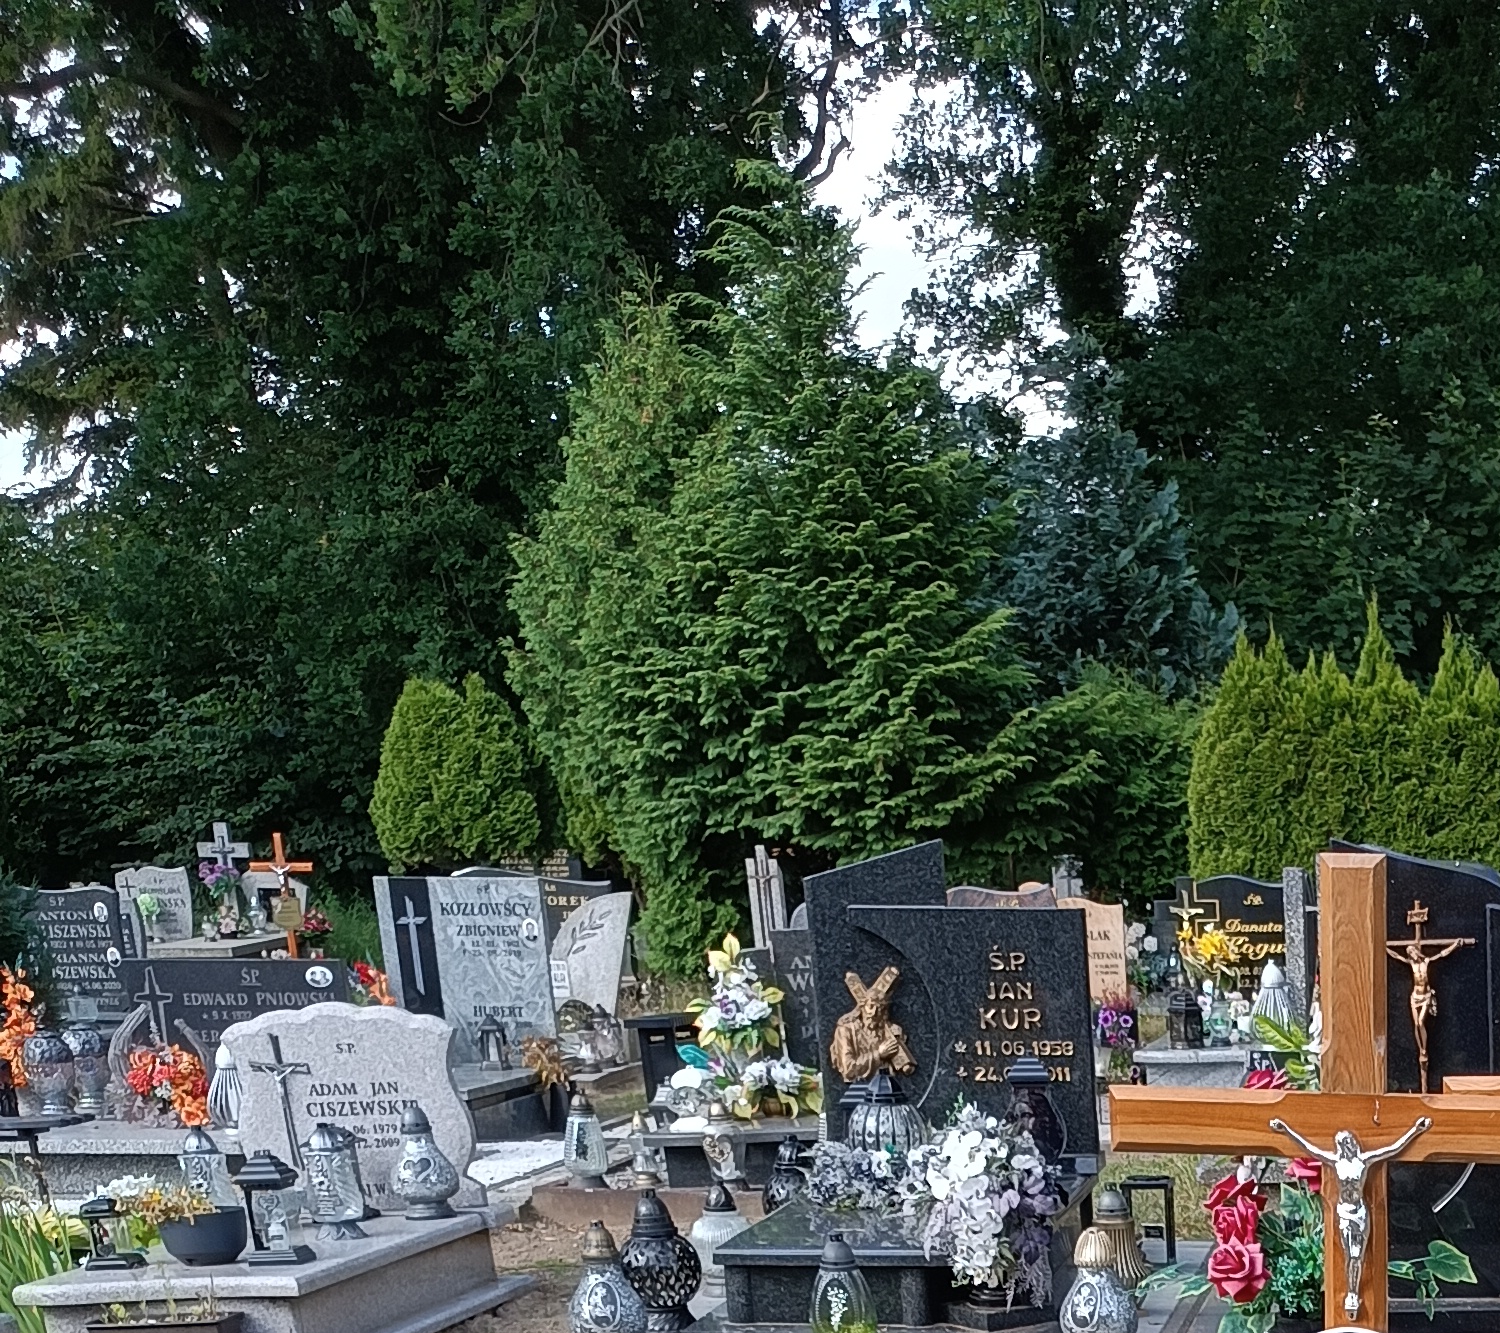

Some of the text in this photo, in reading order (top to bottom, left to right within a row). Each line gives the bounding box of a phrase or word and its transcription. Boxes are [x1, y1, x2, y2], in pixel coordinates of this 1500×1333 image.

[37, 910, 94, 921] ANTONI
[456, 924, 520, 937] ZBIGNIEW
[1225, 919, 1284, 933] Danuta
[987, 981, 1033, 1000] JAN
[182, 992, 248, 1006] EDWARD
[978, 1007, 1042, 1030] KUR
[309, 1081, 399, 1098] ADAM JAN
